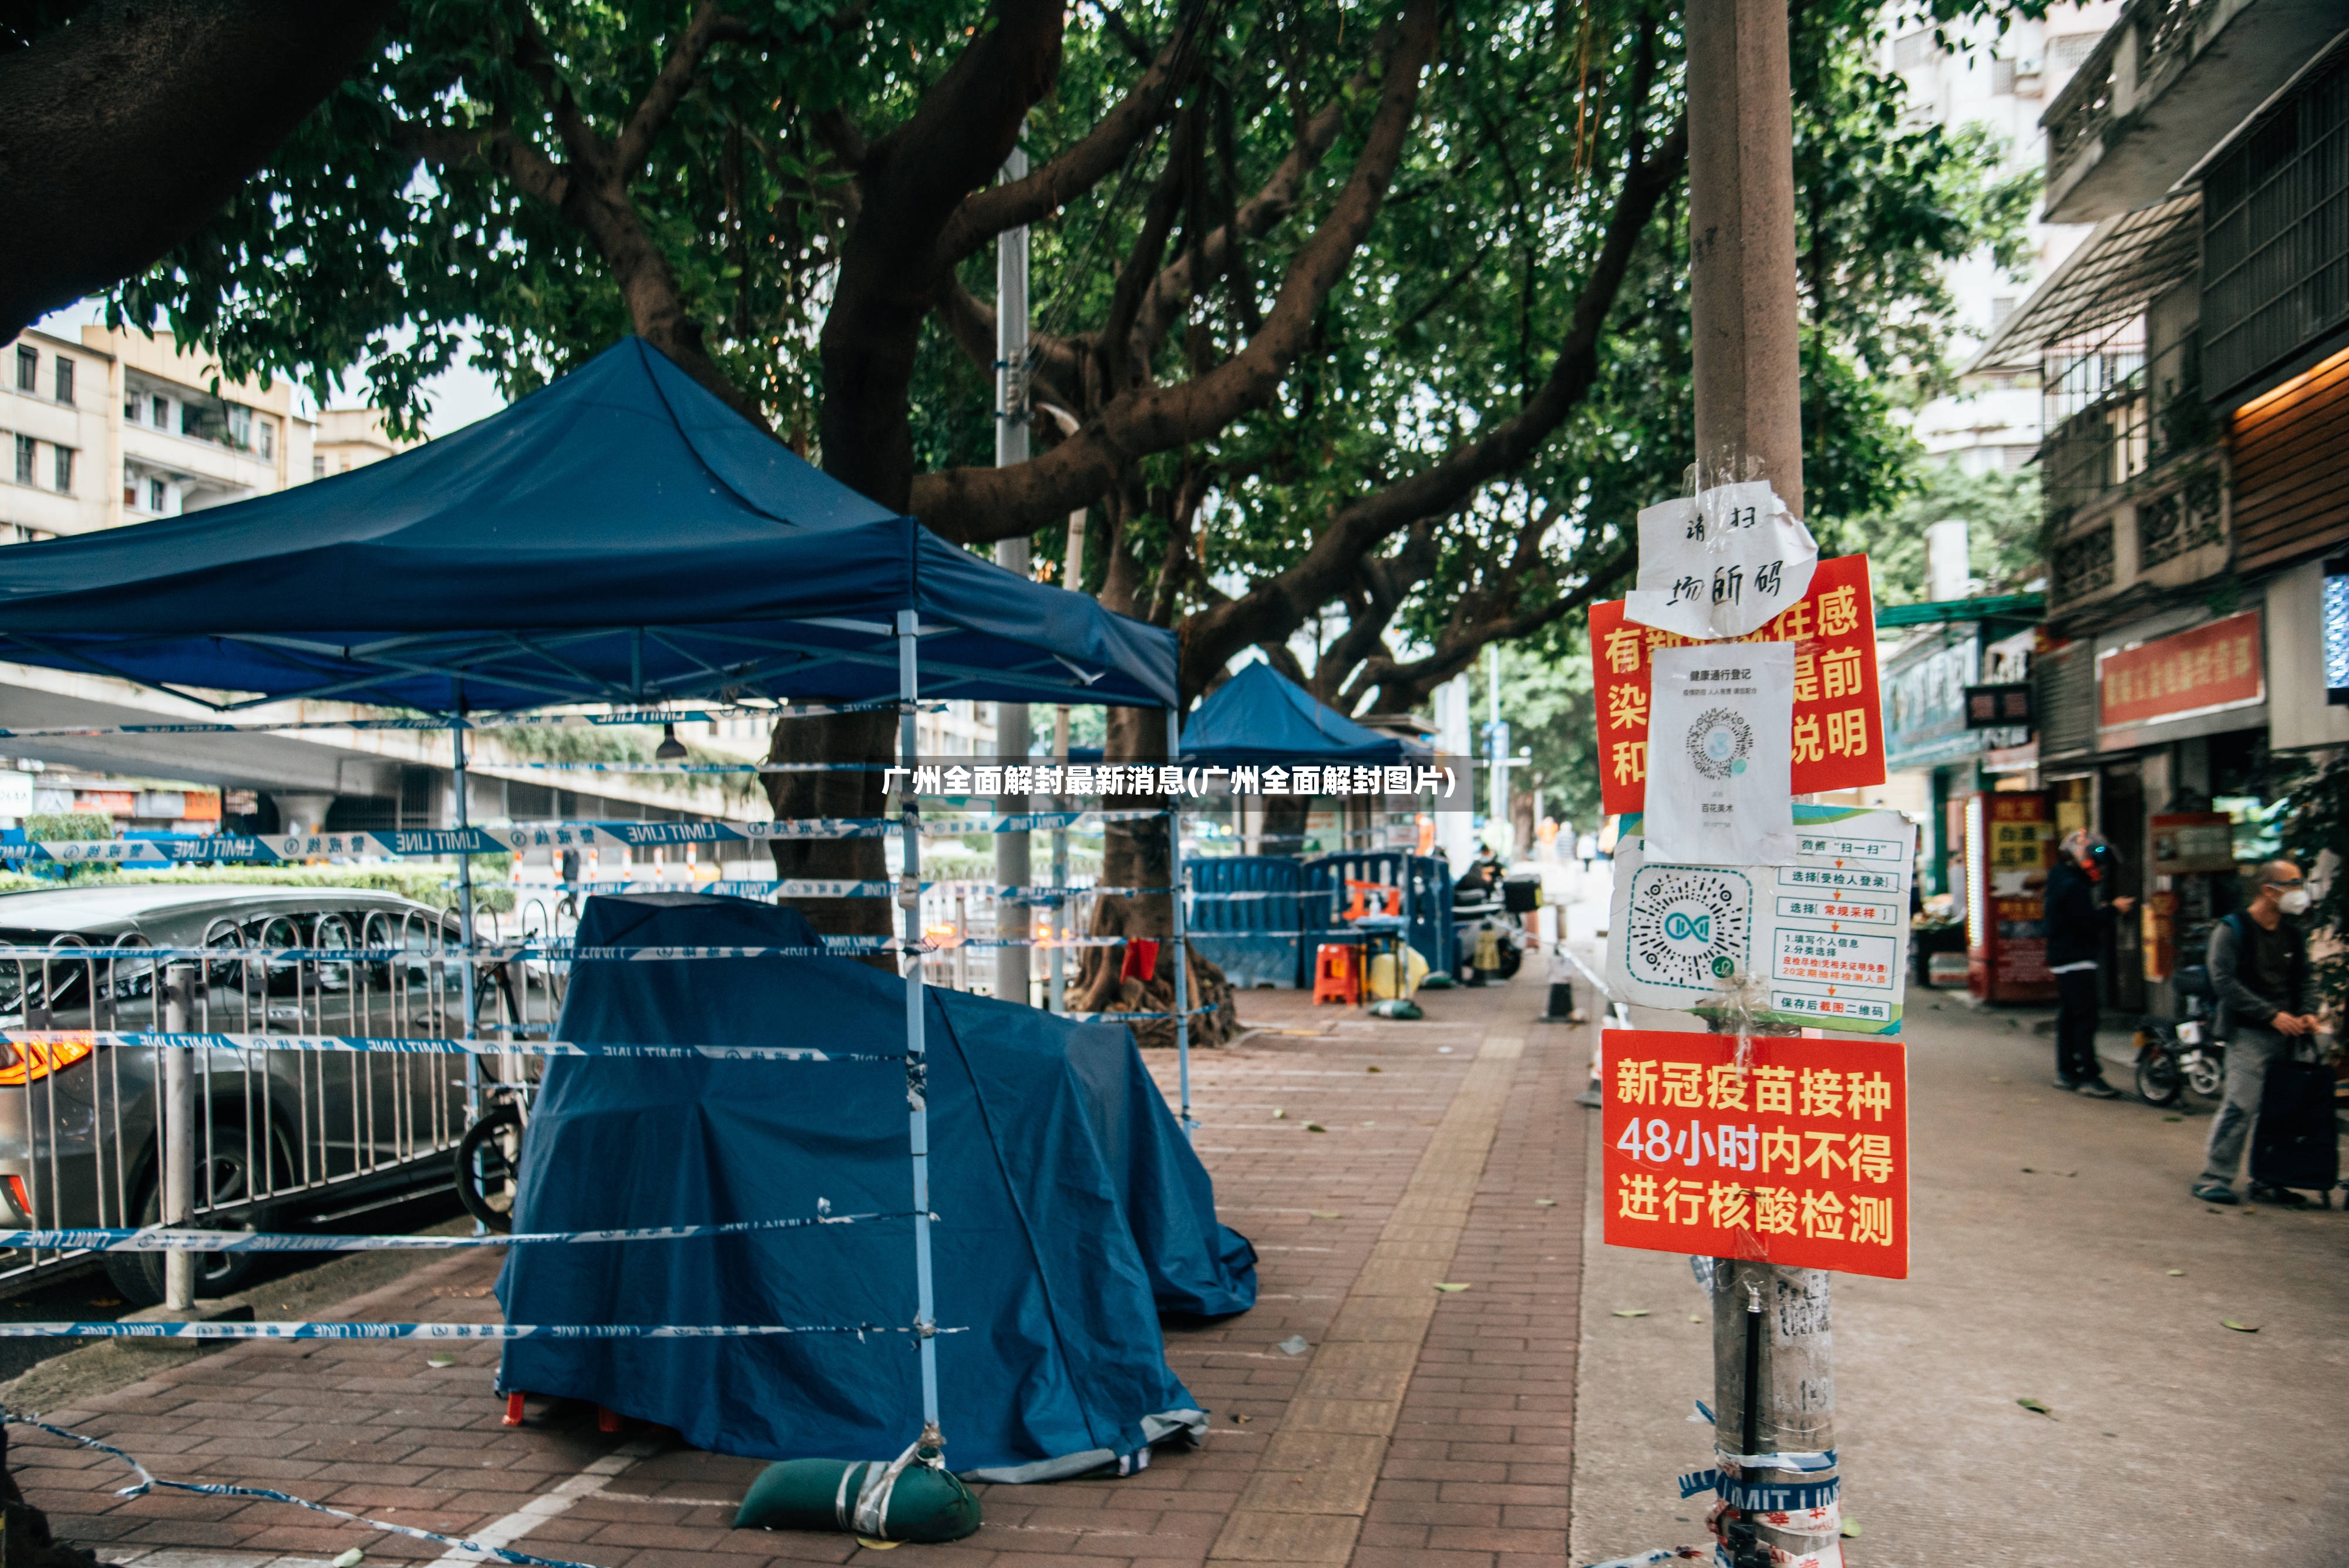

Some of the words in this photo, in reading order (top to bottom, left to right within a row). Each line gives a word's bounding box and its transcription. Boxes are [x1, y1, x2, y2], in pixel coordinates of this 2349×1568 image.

[1666, 560, 1783, 606] 场所码
[1689, 668, 1752, 682] 健康通行登记
[1701, 803, 1734, 814] 百花美术
[1801, 840, 1826, 851] 微信
[1781, 997, 1884, 1018] 保存后截图二维码
[1616, 1057, 1892, 1122] 新冠疫苗接种
[1616, 1117, 1893, 1184] 48小时内不得
[1618, 1173, 1893, 1247] 进行核酸检测
